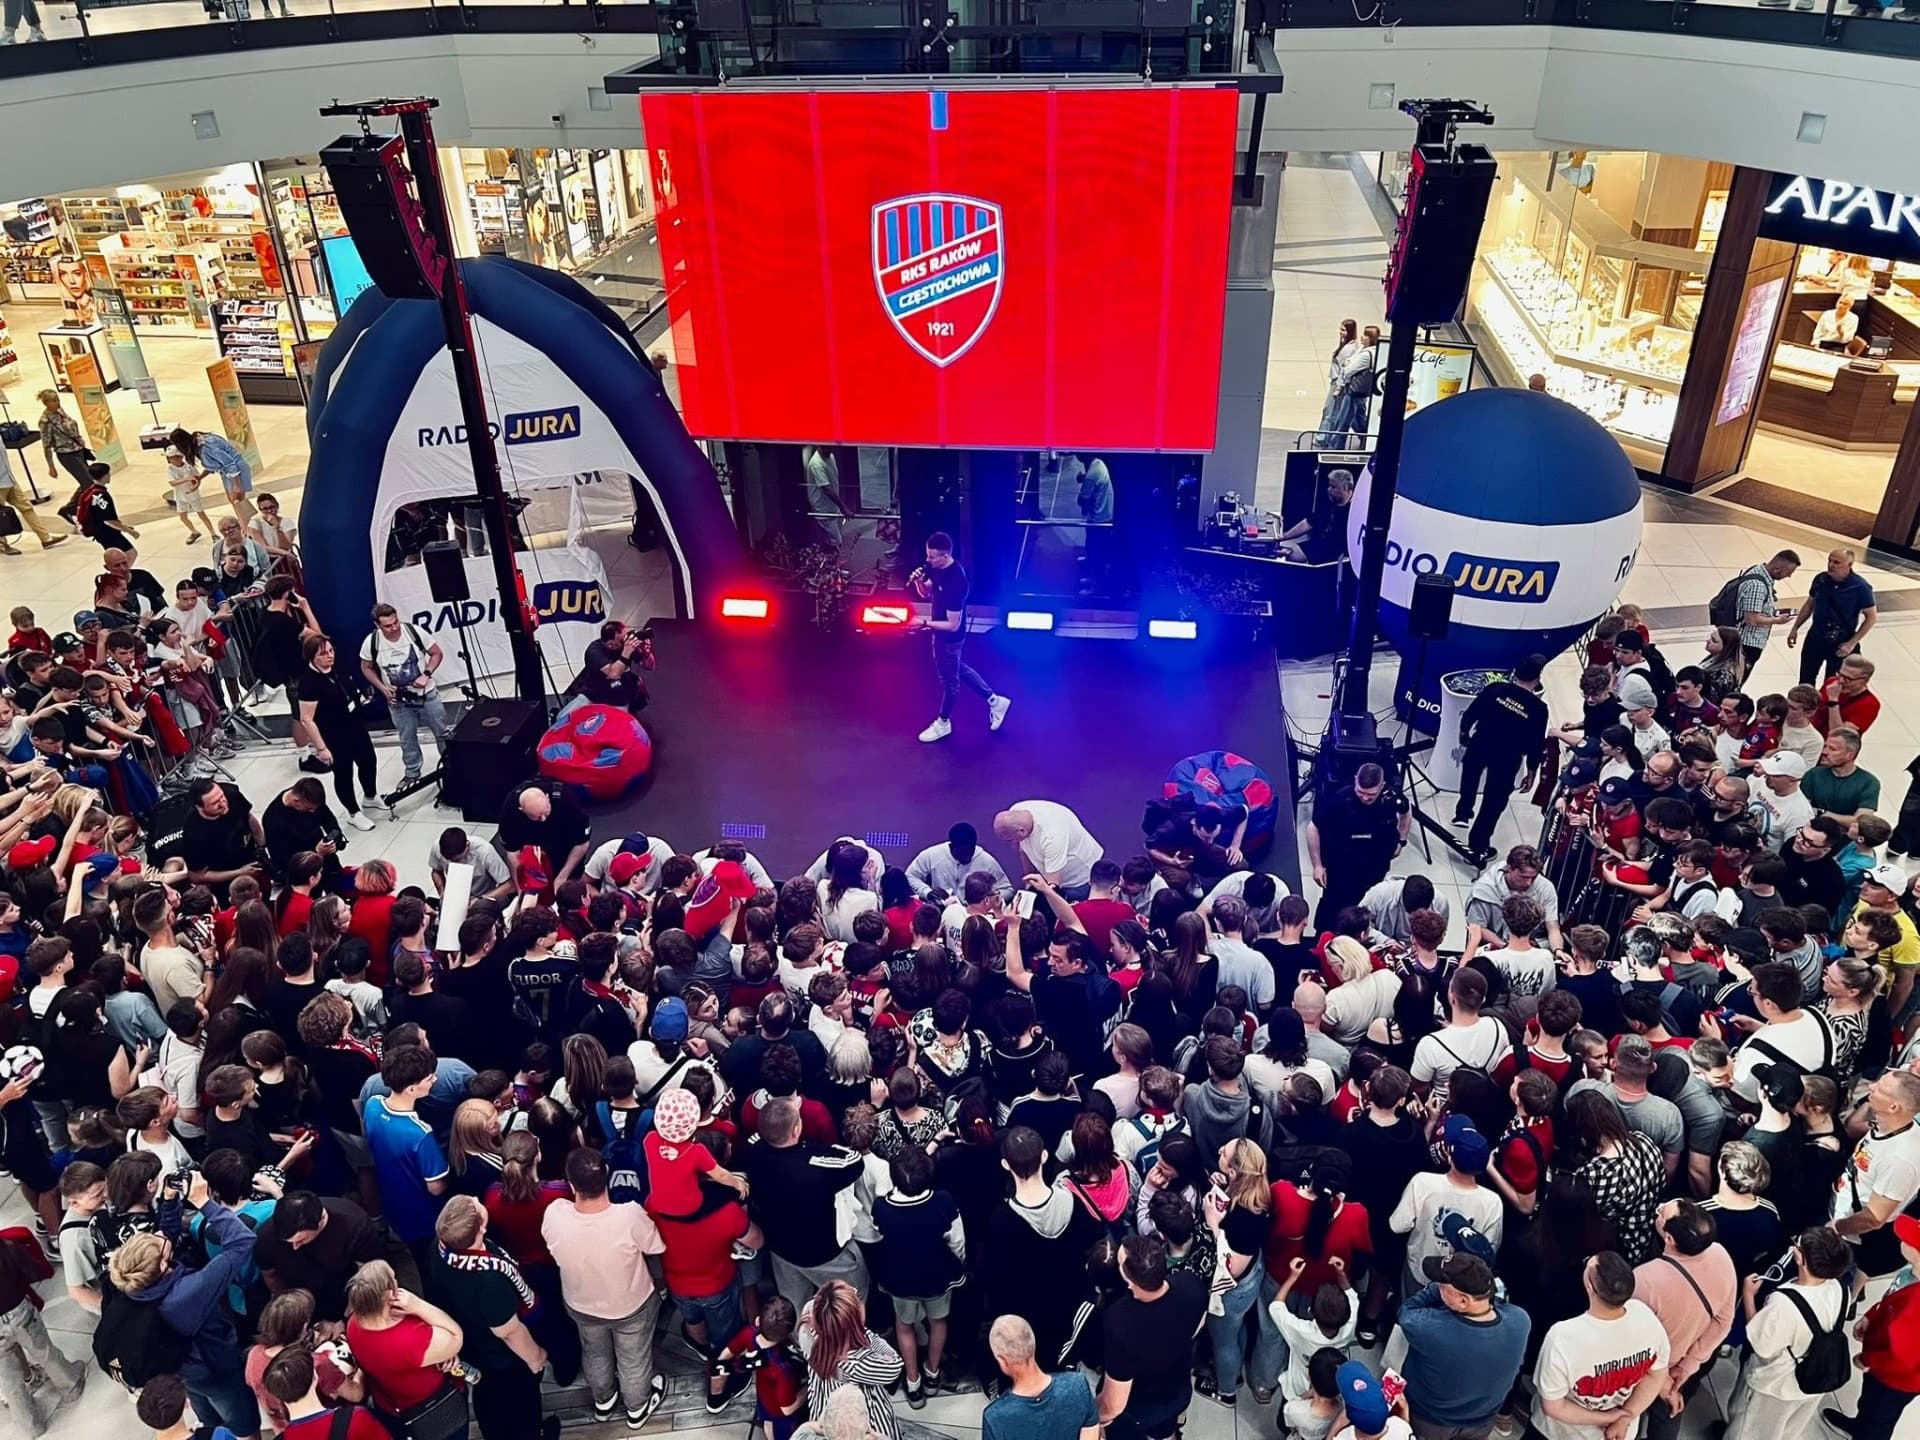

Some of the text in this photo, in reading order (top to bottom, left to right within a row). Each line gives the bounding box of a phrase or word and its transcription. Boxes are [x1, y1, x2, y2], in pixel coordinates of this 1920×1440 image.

[900, 239, 982, 285] RKS RAKÓW
[898, 261, 992, 309] CZĘSTOCHOWA
[927, 322, 954, 337] 1921
[1411, 349, 1447, 369] cCafé
[418, 412, 577, 448] RADO JURA
[1454, 562, 1545, 596] JURA
[412, 588, 604, 634] RADI JUR
[1405, 690, 1440, 713] RDIO
[513, 972, 562, 986] TUDOR
